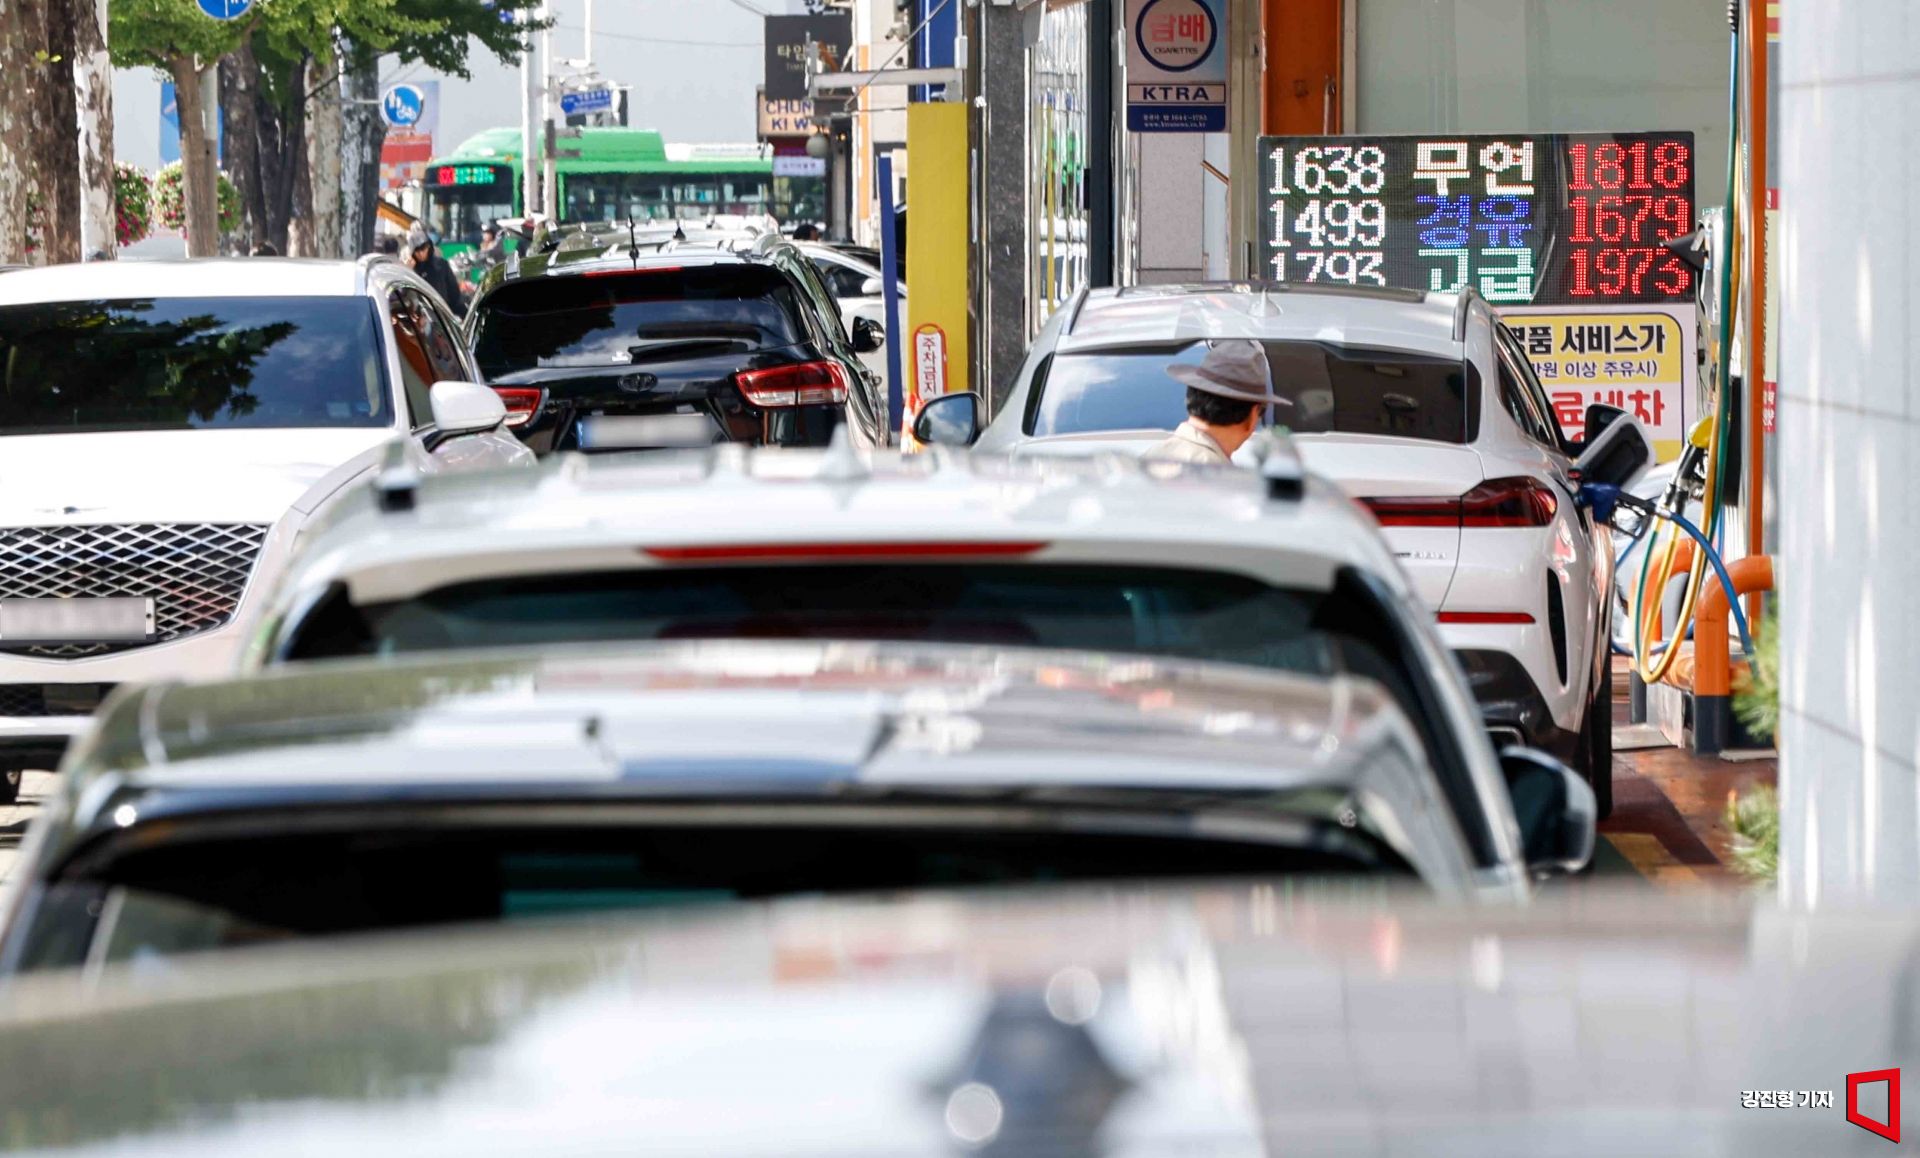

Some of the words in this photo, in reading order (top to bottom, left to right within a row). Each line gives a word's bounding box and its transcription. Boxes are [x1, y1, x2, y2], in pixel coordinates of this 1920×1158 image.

[1150, 14, 1205, 42] 담배
[1143, 87, 1209, 101] KTRA
[1269, 147, 1386, 194] 1638
[1413, 142, 1534, 196] 무연
[1568, 142, 1688, 190] 1818
[1269, 199, 1386, 247] 1499
[1416, 195, 1532, 247] 경유
[1568, 196, 1689, 242] 1679
[1418, 248, 1534, 301] 고급
[1569, 248, 1690, 295] 1973
[1560, 325, 1666, 355] 서비스가
[922, 337, 937, 396] 주차금지
[1565, 361, 1597, 379] 이상
[1603, 360, 1657, 378] 주유시)
